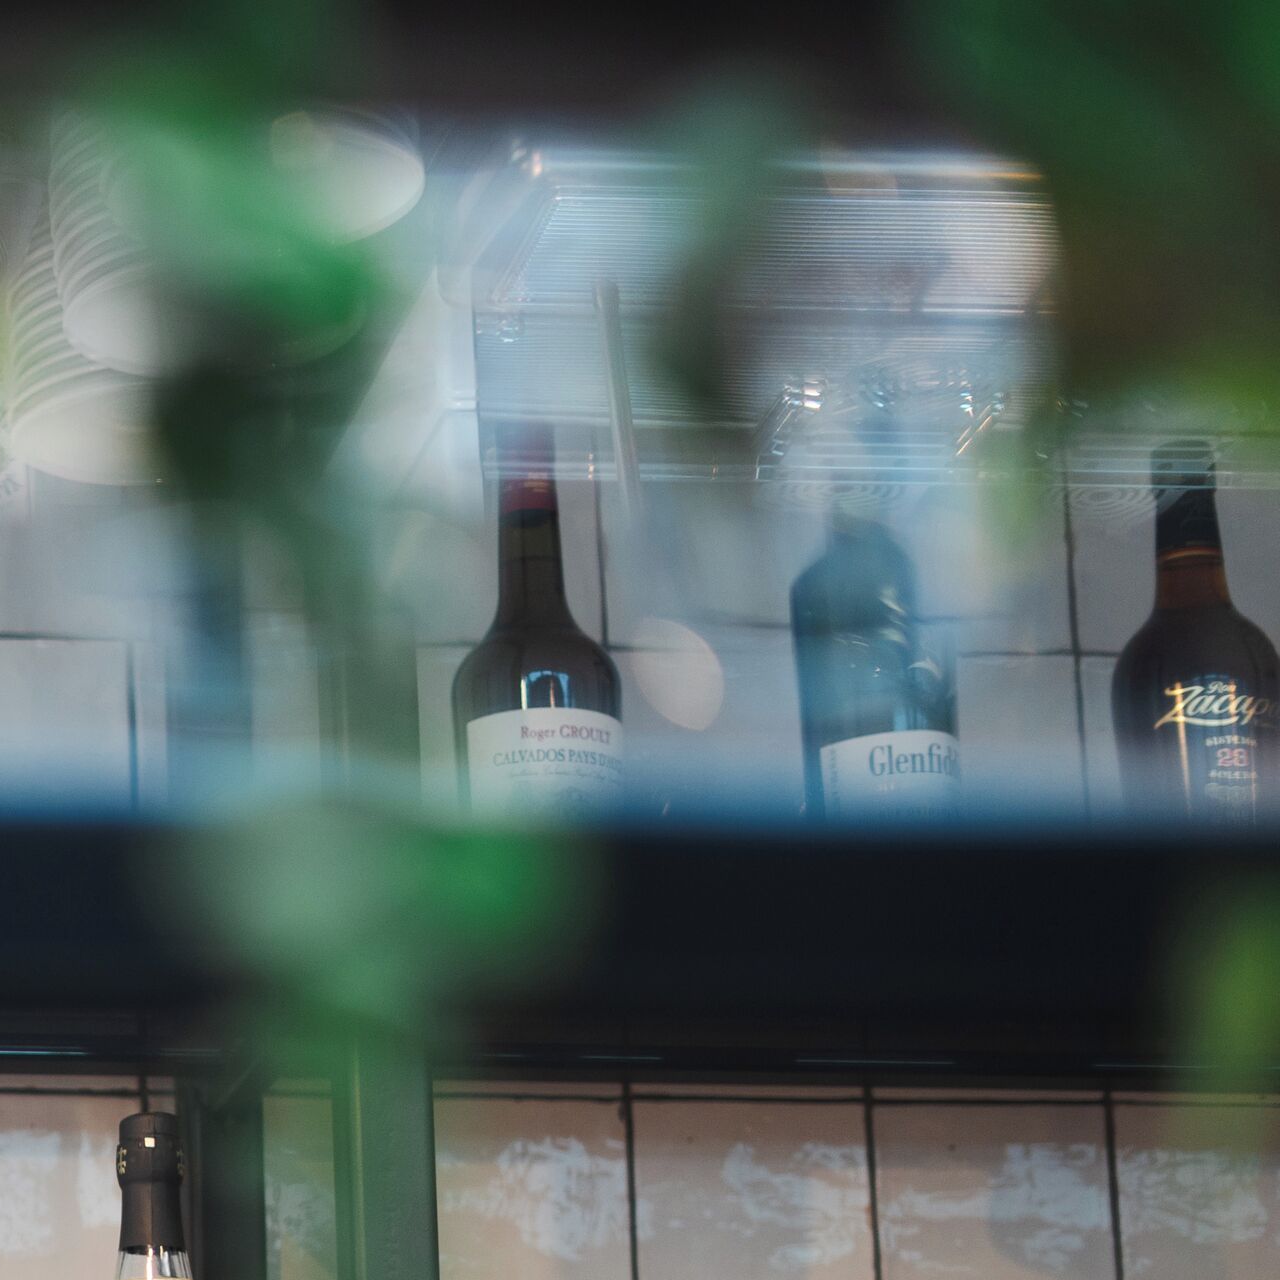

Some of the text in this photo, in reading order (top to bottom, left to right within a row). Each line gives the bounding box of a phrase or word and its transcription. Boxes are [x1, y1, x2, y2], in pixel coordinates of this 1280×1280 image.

[520, 723, 613, 745] Roger GROULT
[493, 749, 565, 767] CALVADOS
[568, 749, 598, 766] PAYS
